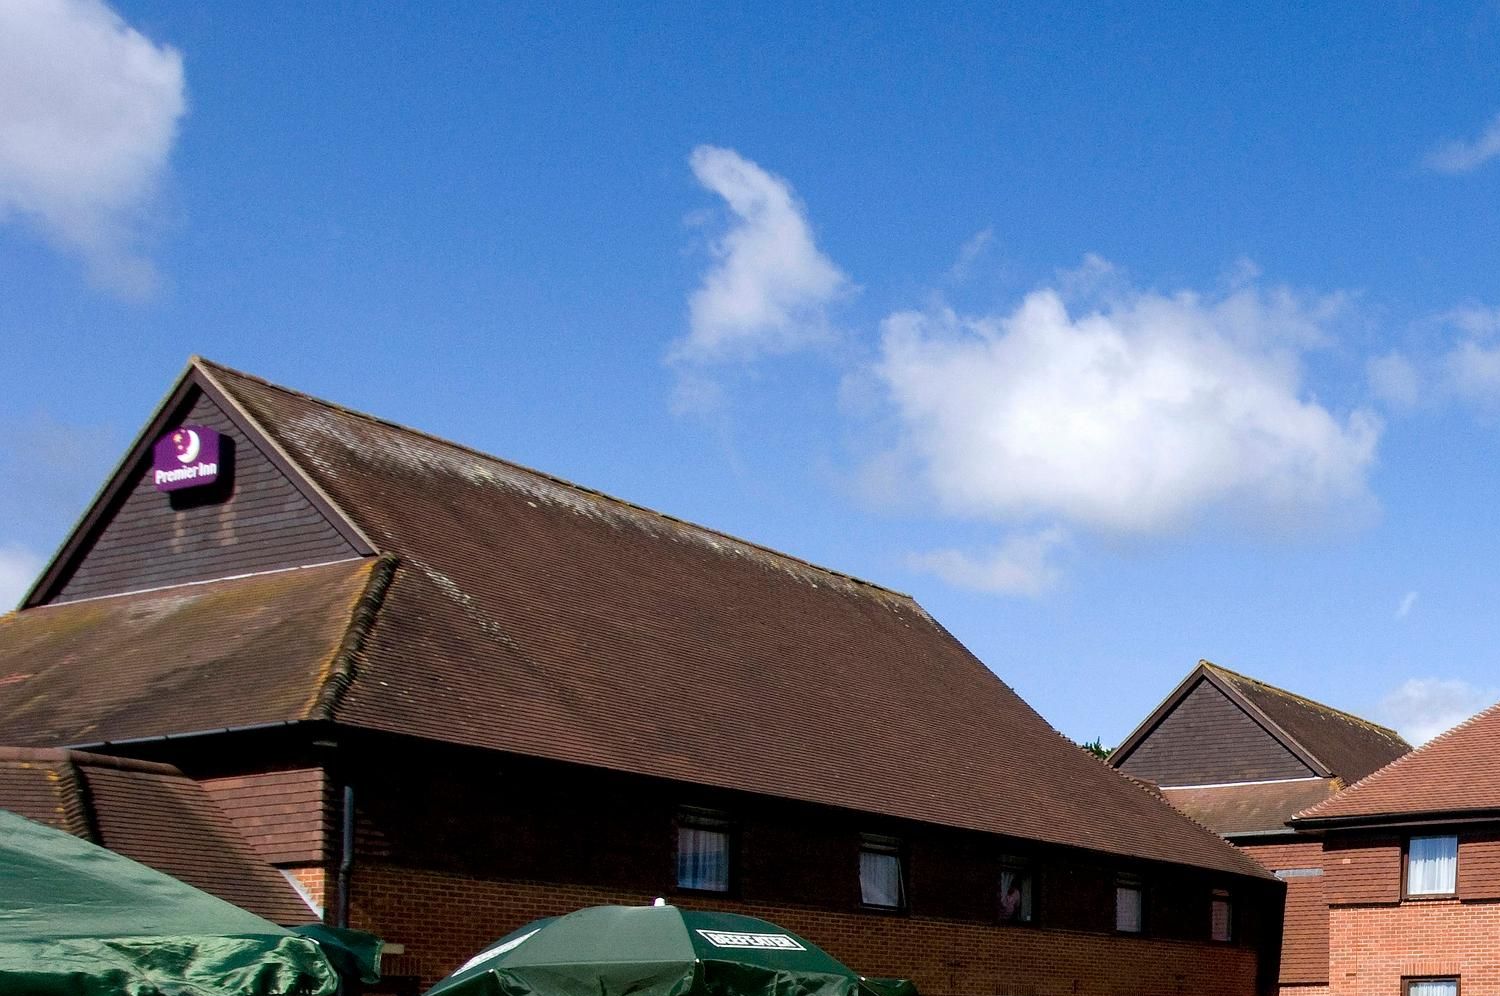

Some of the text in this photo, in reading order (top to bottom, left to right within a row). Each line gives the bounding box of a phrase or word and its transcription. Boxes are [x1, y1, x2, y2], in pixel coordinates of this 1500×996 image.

[155, 462, 217, 484] Premier Inn
[706, 933, 797, 947] BEEFEATER
